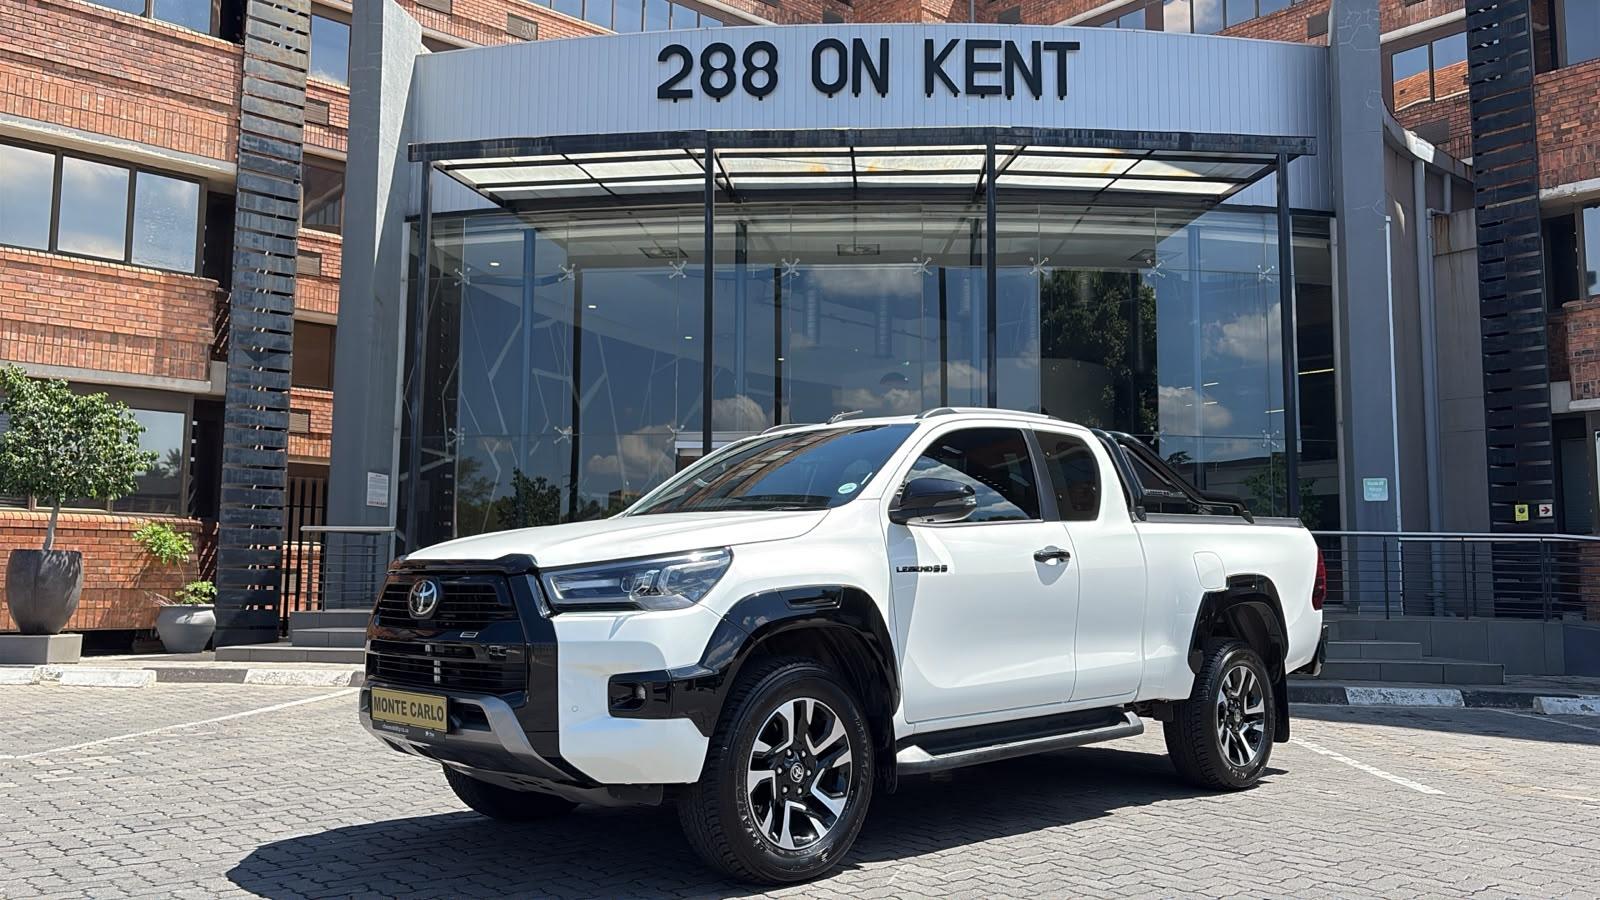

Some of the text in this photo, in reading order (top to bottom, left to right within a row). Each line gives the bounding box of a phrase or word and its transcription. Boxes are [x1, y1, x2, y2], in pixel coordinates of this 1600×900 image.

[657, 37, 1081, 100] 288 ON KENT
[373, 696, 444, 722] MONTE CARLO
